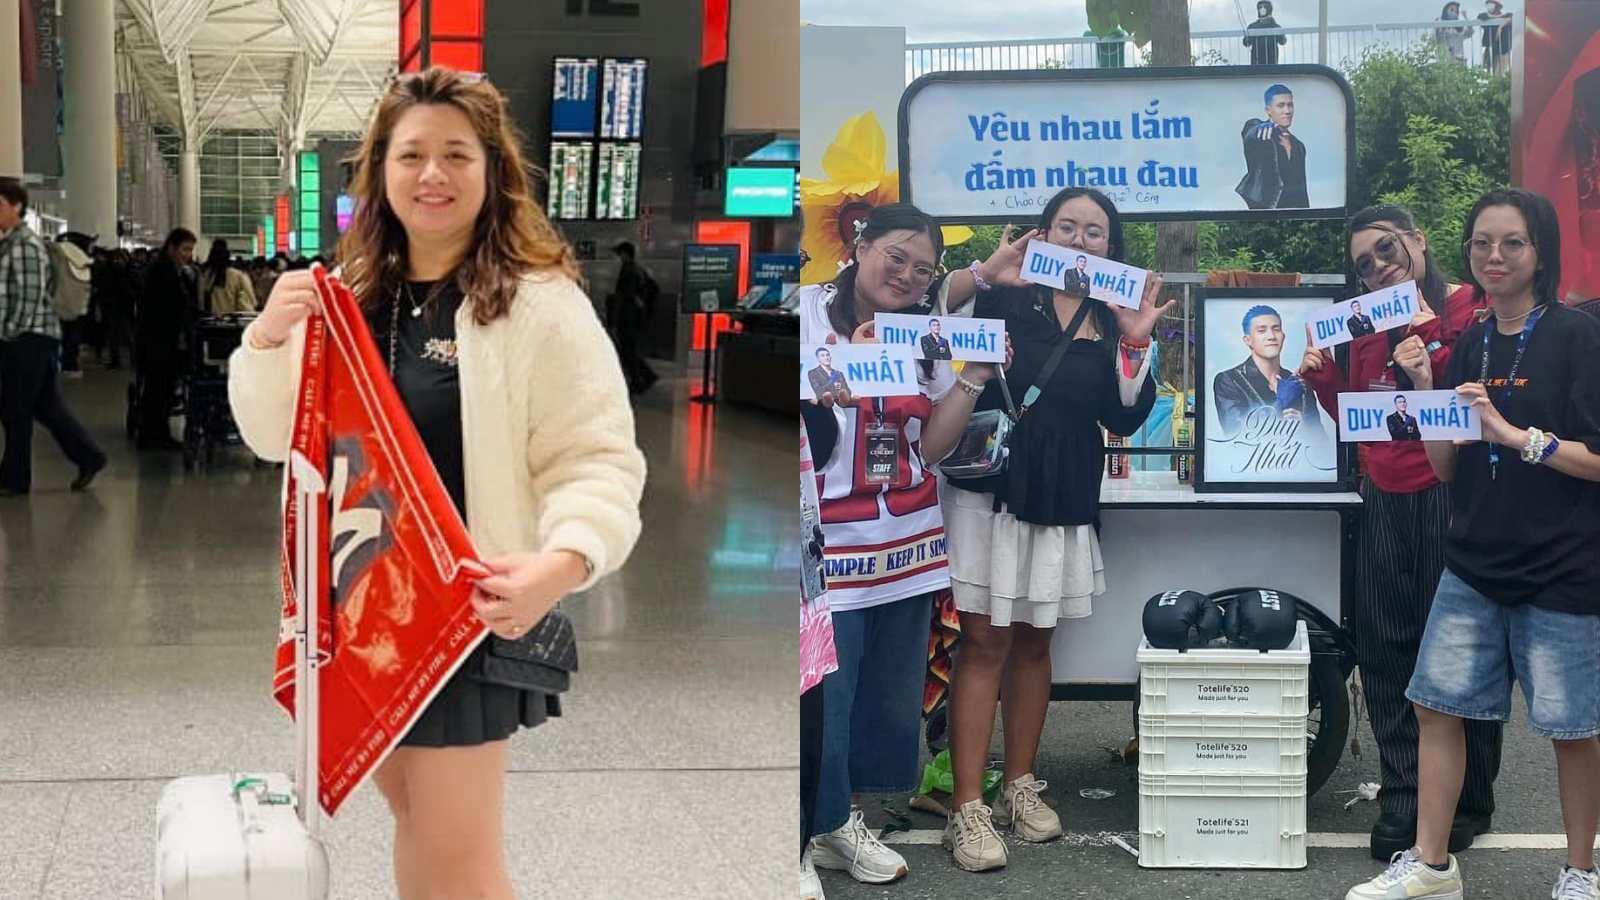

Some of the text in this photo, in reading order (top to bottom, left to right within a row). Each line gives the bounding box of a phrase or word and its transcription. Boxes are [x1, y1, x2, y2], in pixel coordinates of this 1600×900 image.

[968, 99, 1191, 141] Yêu nhau lắm
[965, 150, 1199, 191] đấm nhau đau
[1030, 252, 1137, 299] DUY NHẤT
[1316, 290, 1411, 340] DUY NHẤT
[952, 324, 997, 353] NHẤT
[849, 350, 905, 383] NHẤT
[1347, 396, 1471, 432] DUY NHẤT
[872, 463, 892, 473] STAFF
[825, 537, 947, 577] IMPLE KEEP IT SIM
